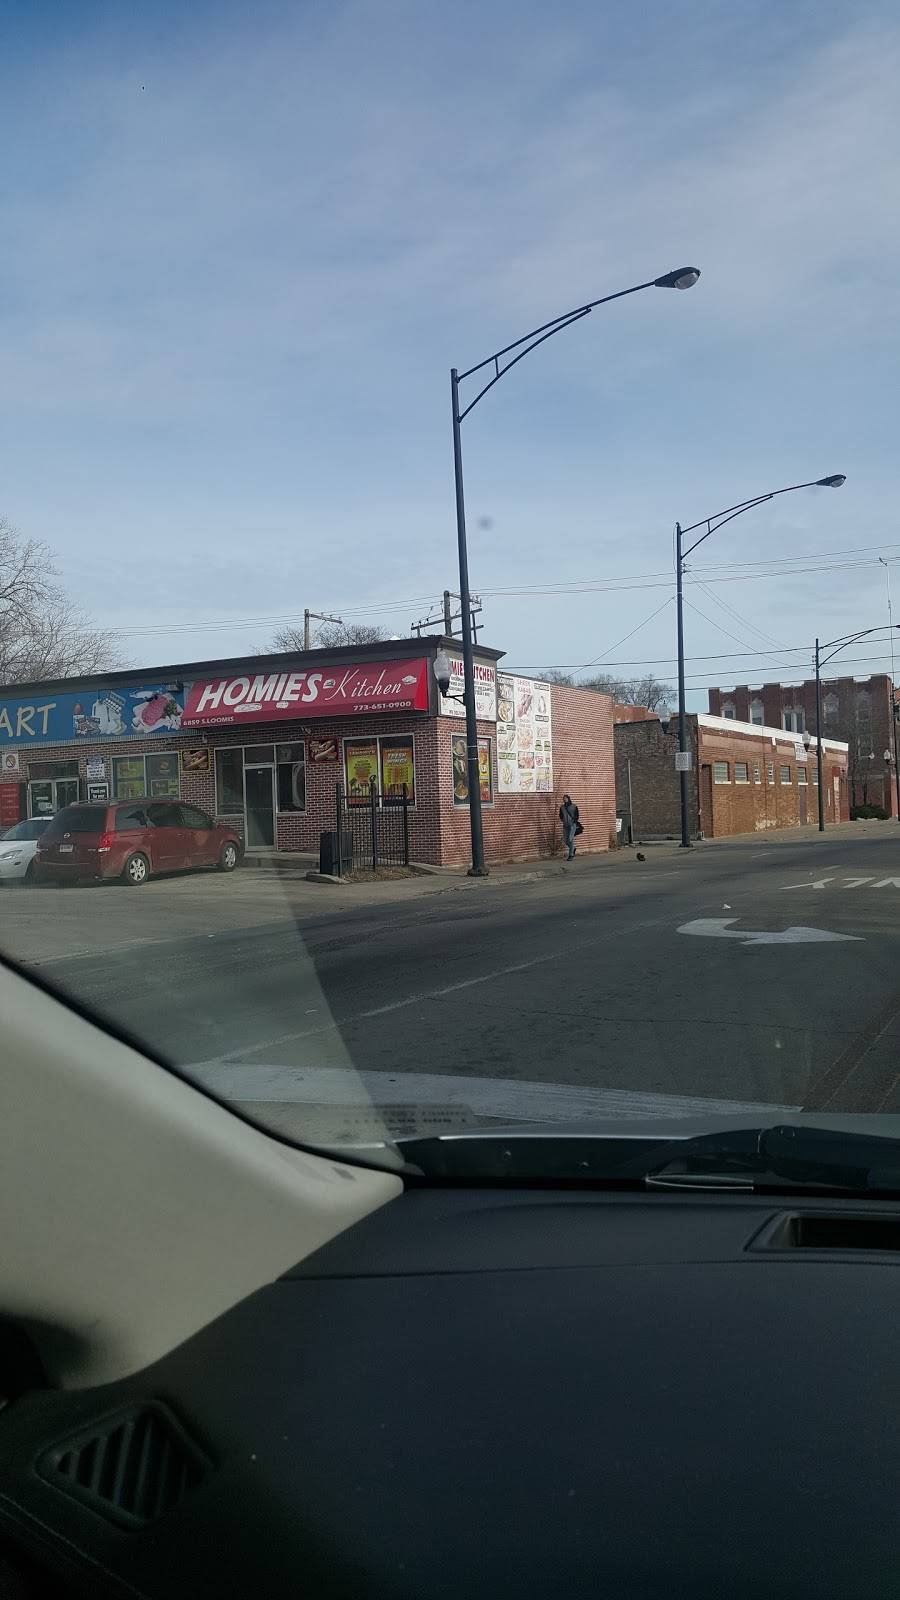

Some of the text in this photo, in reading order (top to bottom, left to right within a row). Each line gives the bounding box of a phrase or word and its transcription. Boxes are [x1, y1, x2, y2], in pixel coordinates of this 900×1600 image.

[473, 665, 495, 682] ITCHEN
[195, 668, 402, 713] HOMIES Kitchen
[353, 700, 412, 711] 773-651-0900
[183, 719, 200, 727] 6859
